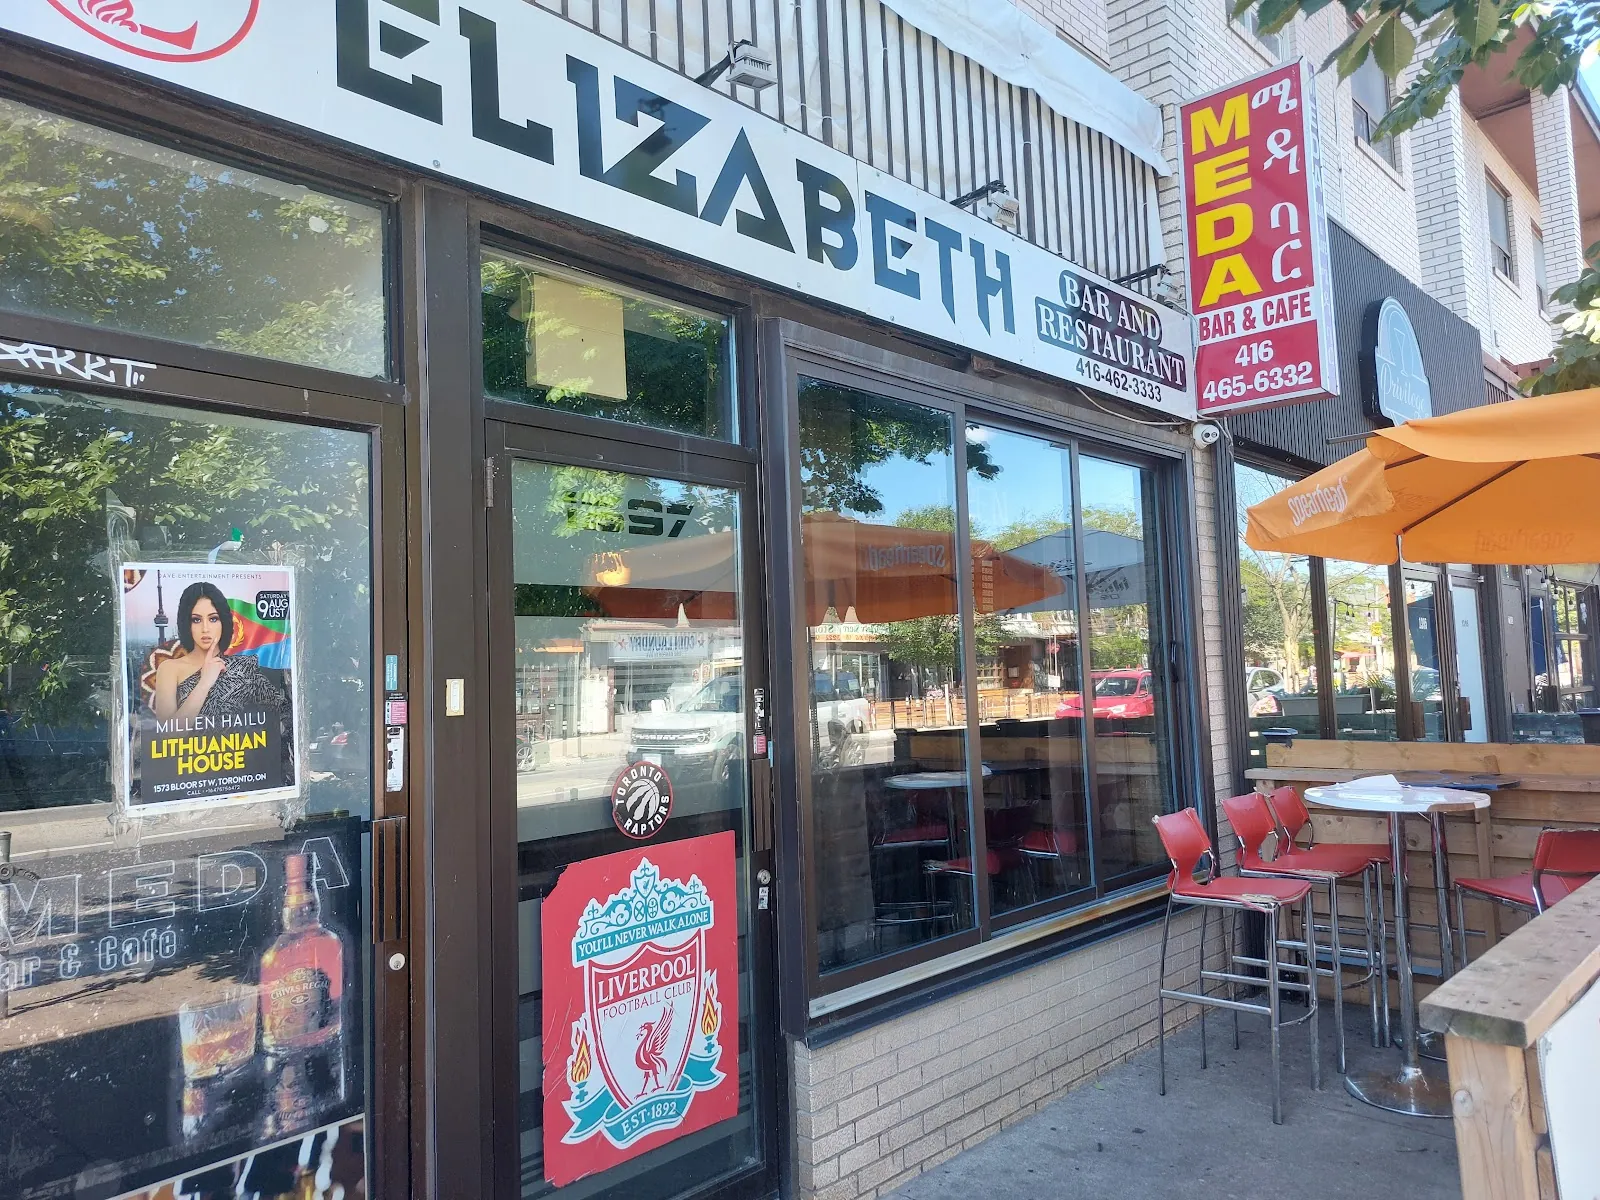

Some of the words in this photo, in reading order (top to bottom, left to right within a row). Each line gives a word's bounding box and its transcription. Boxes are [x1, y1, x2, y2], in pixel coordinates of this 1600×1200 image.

[336, 0, 1016, 338] ELIZABETH
[1190, 92, 1263, 308] MEDA
[1063, 274, 1113, 323] BAR
[1117, 300, 1161, 342] AND
[1199, 310, 1236, 342] BAR
[1242, 305, 1257, 331] &
[1262, 291, 1312, 327] CAFE
[1037, 303, 1184, 386] RESTAURANT
[1234, 339, 1274, 367] 416
[1075, 357, 1162, 403] 416-462-3333
[1202, 360, 1313, 403] 465-6332
[257, 600, 269, 619] 9
[269, 598, 289, 608] AUG
[156, 715, 215, 734] MILLEN
[221, 711, 266, 728] HAILU
[151, 730, 267, 759] LITHUANIAN
[177, 750, 246, 776] HOUSE
[153, 783, 170, 793] 1573
[170, 780, 198, 791] BLOOR
[198, 779, 208, 788] ST
[218, 774, 255, 785] TORONTO,
[255, 772, 267, 781] ON
[615, 765, 662, 806] TORONTO
[623, 795, 670, 835] RAPTORS
[577, 937, 615, 958] YOU'LL
[614, 927, 648, 948] NEVER
[647, 919, 678, 937] WALK
[677, 909, 709, 930] ALONE
[60, 943, 82, 979] &
[597, 953, 696, 1005] LIVERPOOL
[270, 984, 301, 1001] CHIVAS
[602, 990, 662, 1022] FOOTBALL
[664, 980, 693, 1000] CLUB
